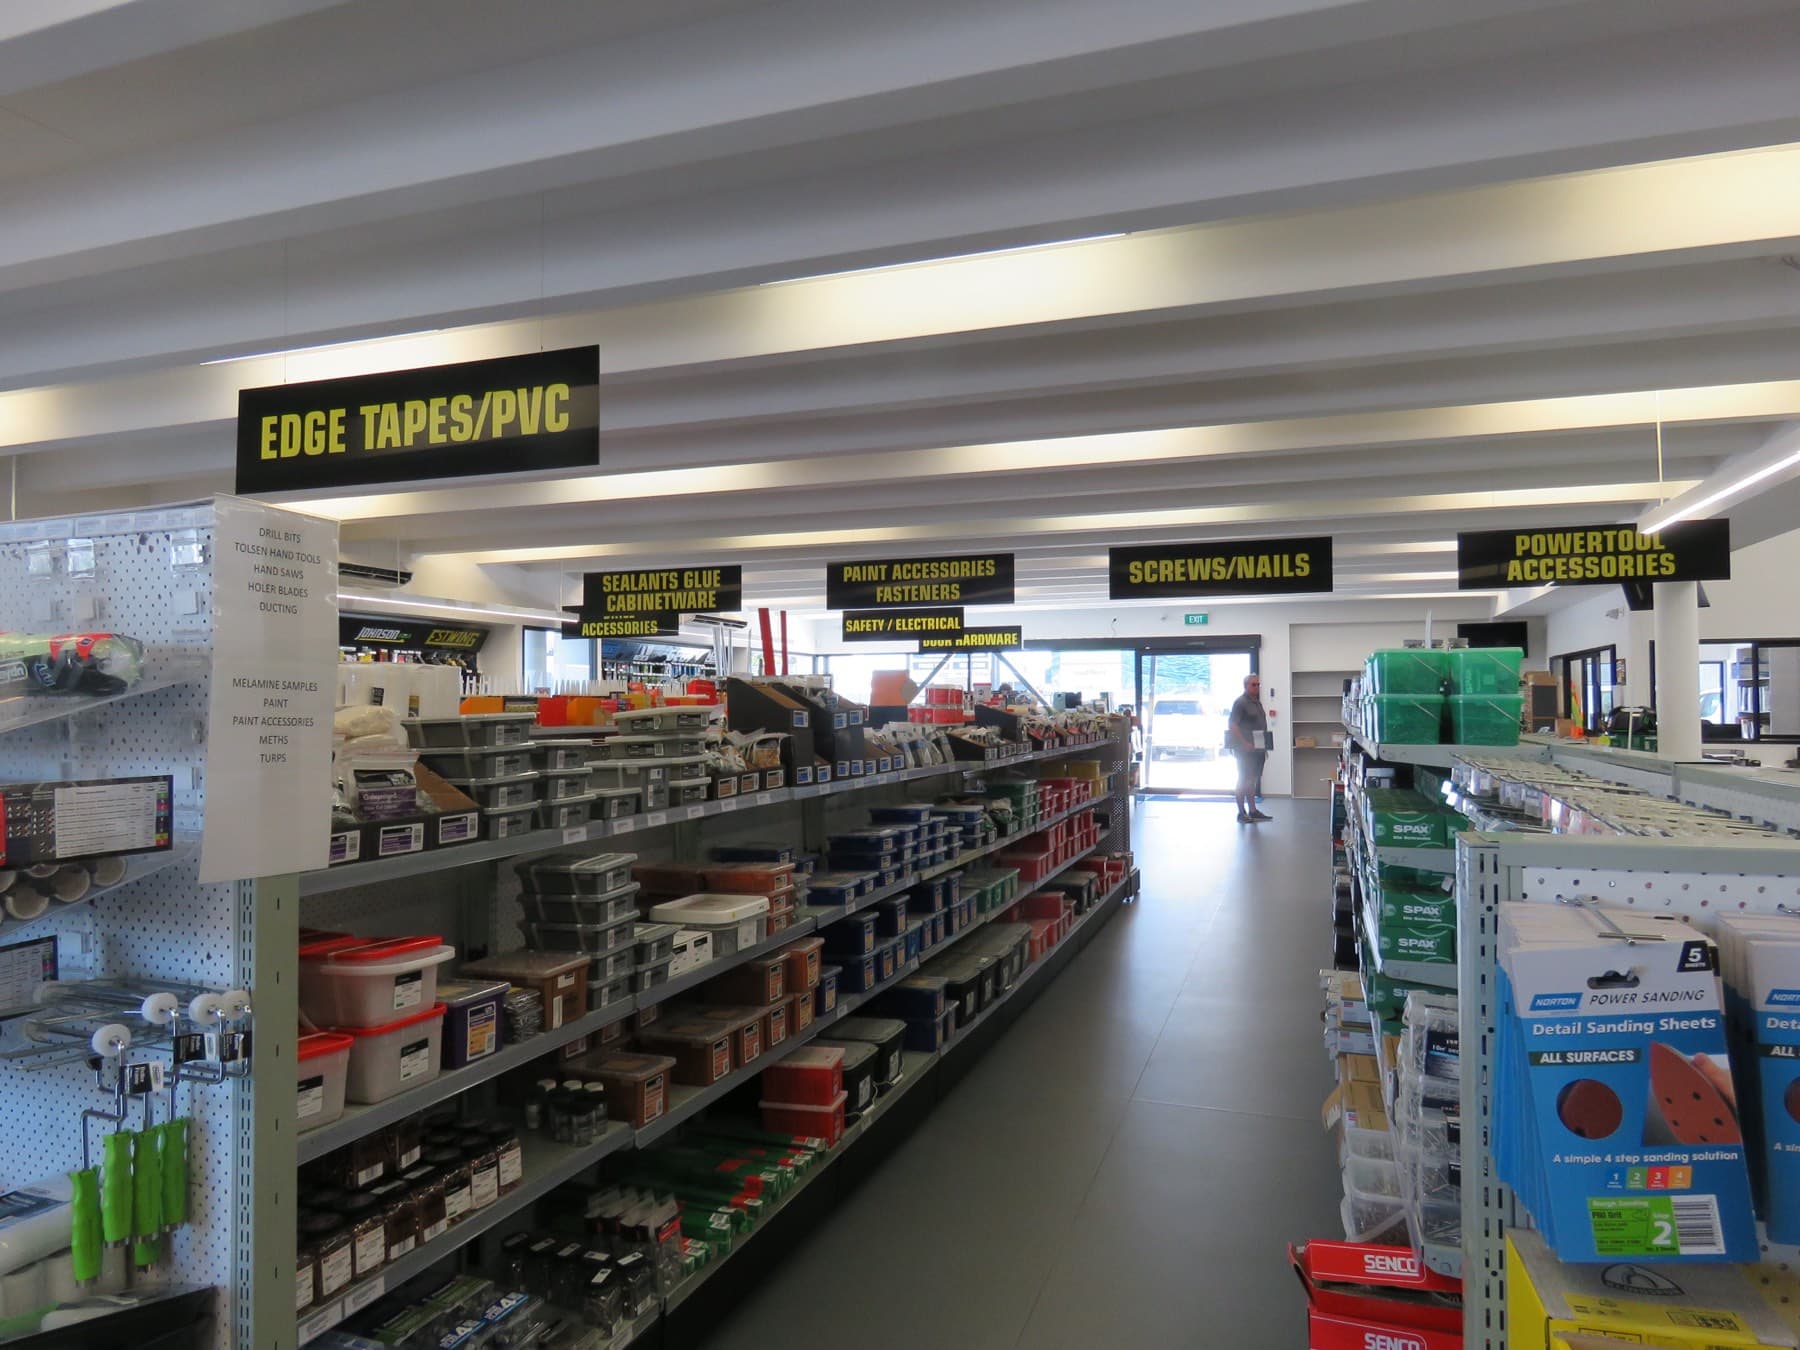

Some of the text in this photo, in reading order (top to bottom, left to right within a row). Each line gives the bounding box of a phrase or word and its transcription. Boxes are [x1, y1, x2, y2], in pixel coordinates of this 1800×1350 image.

[260, 383, 570, 460] EDGE TAPES/PVC
[259, 527, 302, 544] DRILL BITS
[1515, 529, 1665, 556] POWERTOOL
[235, 542, 321, 565] TOLSEN HAND TOOLS
[254, 565, 304, 580] HAND SAWS
[843, 559, 995, 583] PAINT ACCESSORIES
[1129, 553, 1310, 583] SCREWS/NAILS
[1507, 553, 1676, 581] ACCESSORIES
[602, 569, 721, 593] SEALANTS GLUE
[248, 582, 309, 598] HOLER BLADES
[876, 583, 960, 603] FASTENERS
[259, 602, 298, 615] DUCTING
[607, 590, 716, 613] CABINETWARE
[846, 616, 961, 632] SAFETY / ELECTRICAL
[1189, 615, 1203, 624] EXIT
[582, 620, 658, 637] ACCESSORIES
[232, 678, 318, 692] MELAMINE SAMPLES
[263, 698, 289, 709] PAINT
[232, 715, 314, 728] PAINT ACCESSORIES
[259, 735, 289, 745] METHS
[260, 753, 287, 764] TURPS
[1393, 823, 1431, 835] SPAX
[1403, 904, 1441, 915] SPAX
[1398, 937, 1436, 949] SPAX
[1687, 947, 1703, 963] 5
[1535, 997, 1576, 1007] NORTON
[1589, 989, 1705, 1006] POWER SANDING
[1532, 1016, 1717, 1036] Detail Sanding Sheets
[1540, 1051, 1635, 1064] ALL SURFACES
[1771, 1046, 1795, 1057] ALL
[1774, 1142, 1782, 1150] A
[1553, 1150, 1739, 1166] A simple 4 step sanding solution
[1633, 1172, 1641, 1180] 2
[1655, 1172, 1662, 1180] 3
[1651, 1220, 1672, 1246] 2
[1364, 1254, 1420, 1273] SENCO
[1364, 1332, 1420, 1350] SENCO
